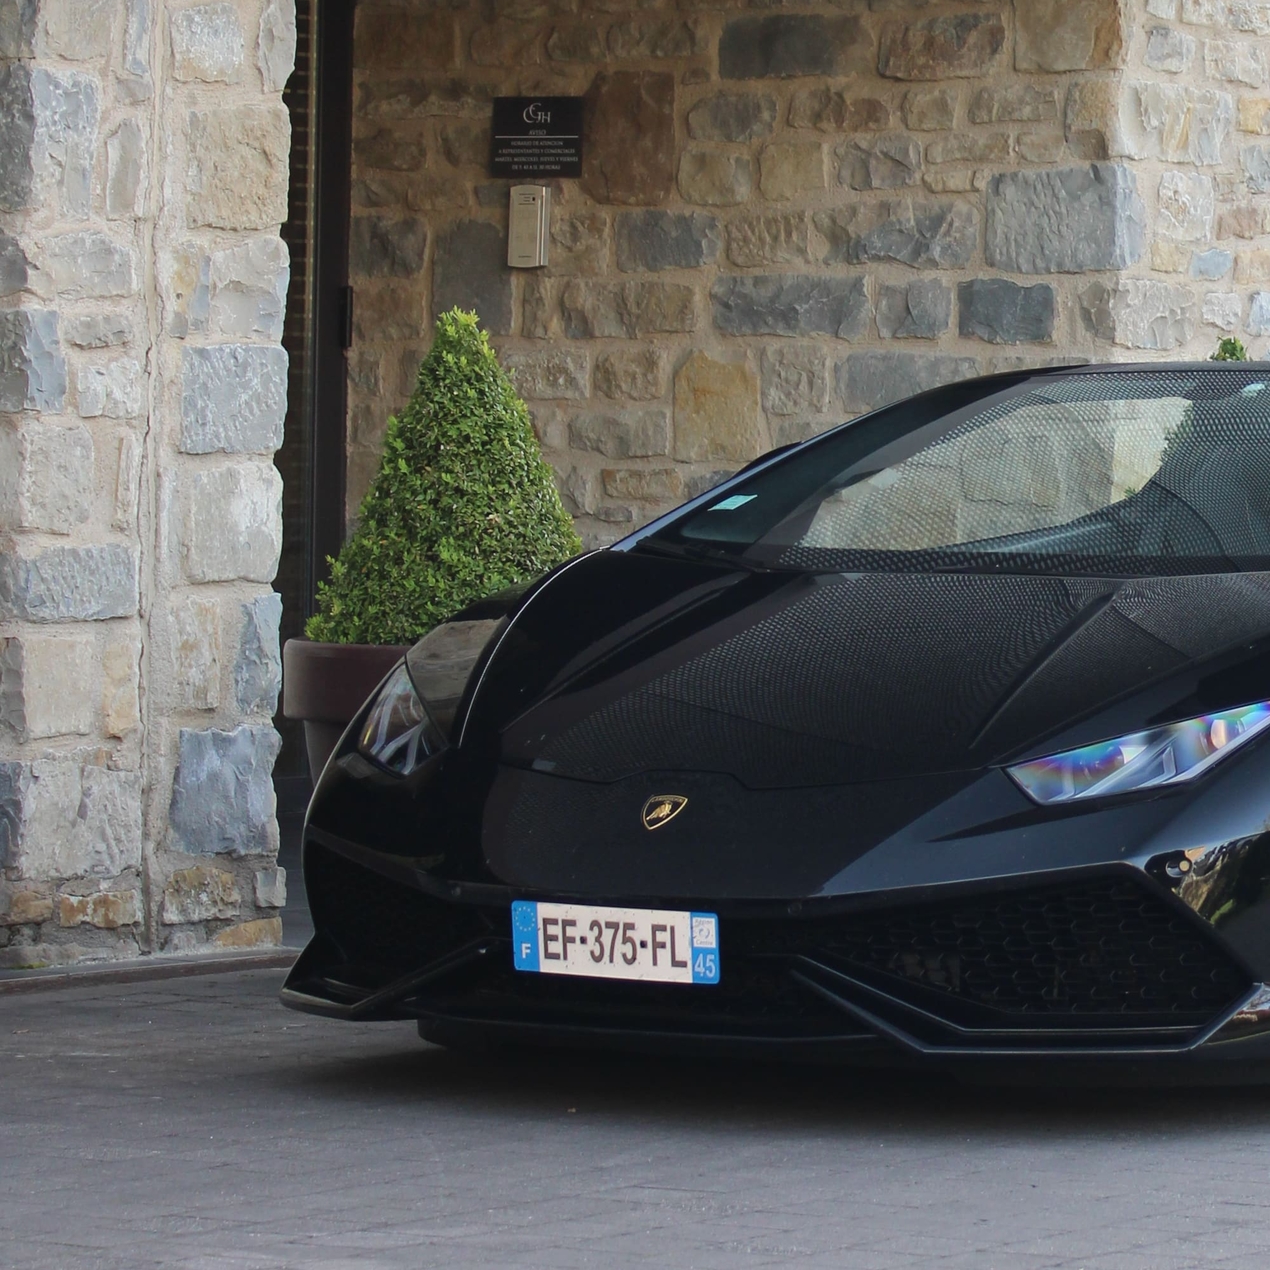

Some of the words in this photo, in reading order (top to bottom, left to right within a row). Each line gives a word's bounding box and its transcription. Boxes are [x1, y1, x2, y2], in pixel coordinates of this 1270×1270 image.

[521, 943, 532, 959] F
[543, 917, 688, 969] EF-375-FL
[694, 952, 716, 979] 45
